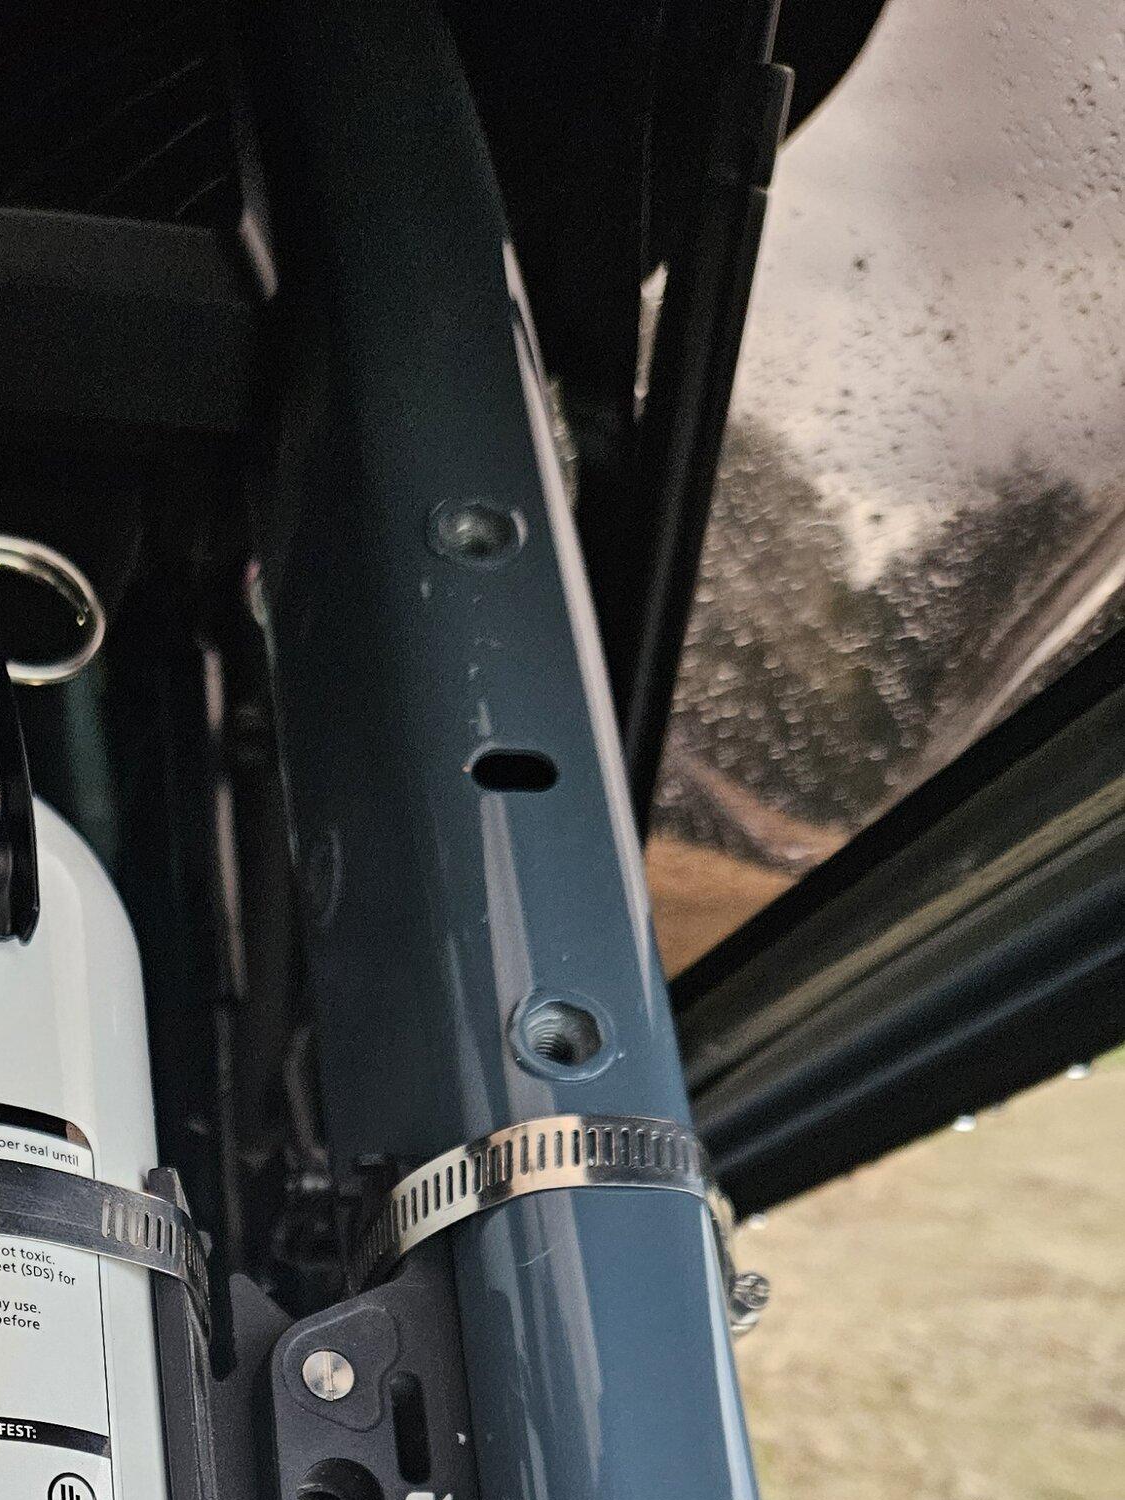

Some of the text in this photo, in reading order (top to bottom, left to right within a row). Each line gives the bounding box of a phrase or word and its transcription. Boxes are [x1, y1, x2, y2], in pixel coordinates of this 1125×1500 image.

[23, 1143, 49, 1158] seal
[51, 1150, 79, 1167] until
[19, 1248, 56, 1266] toxic.
[20, 1262, 55, 1283] (SDS)
[57, 1270, 76, 1286] for
[13, 1301, 42, 1315] use.
